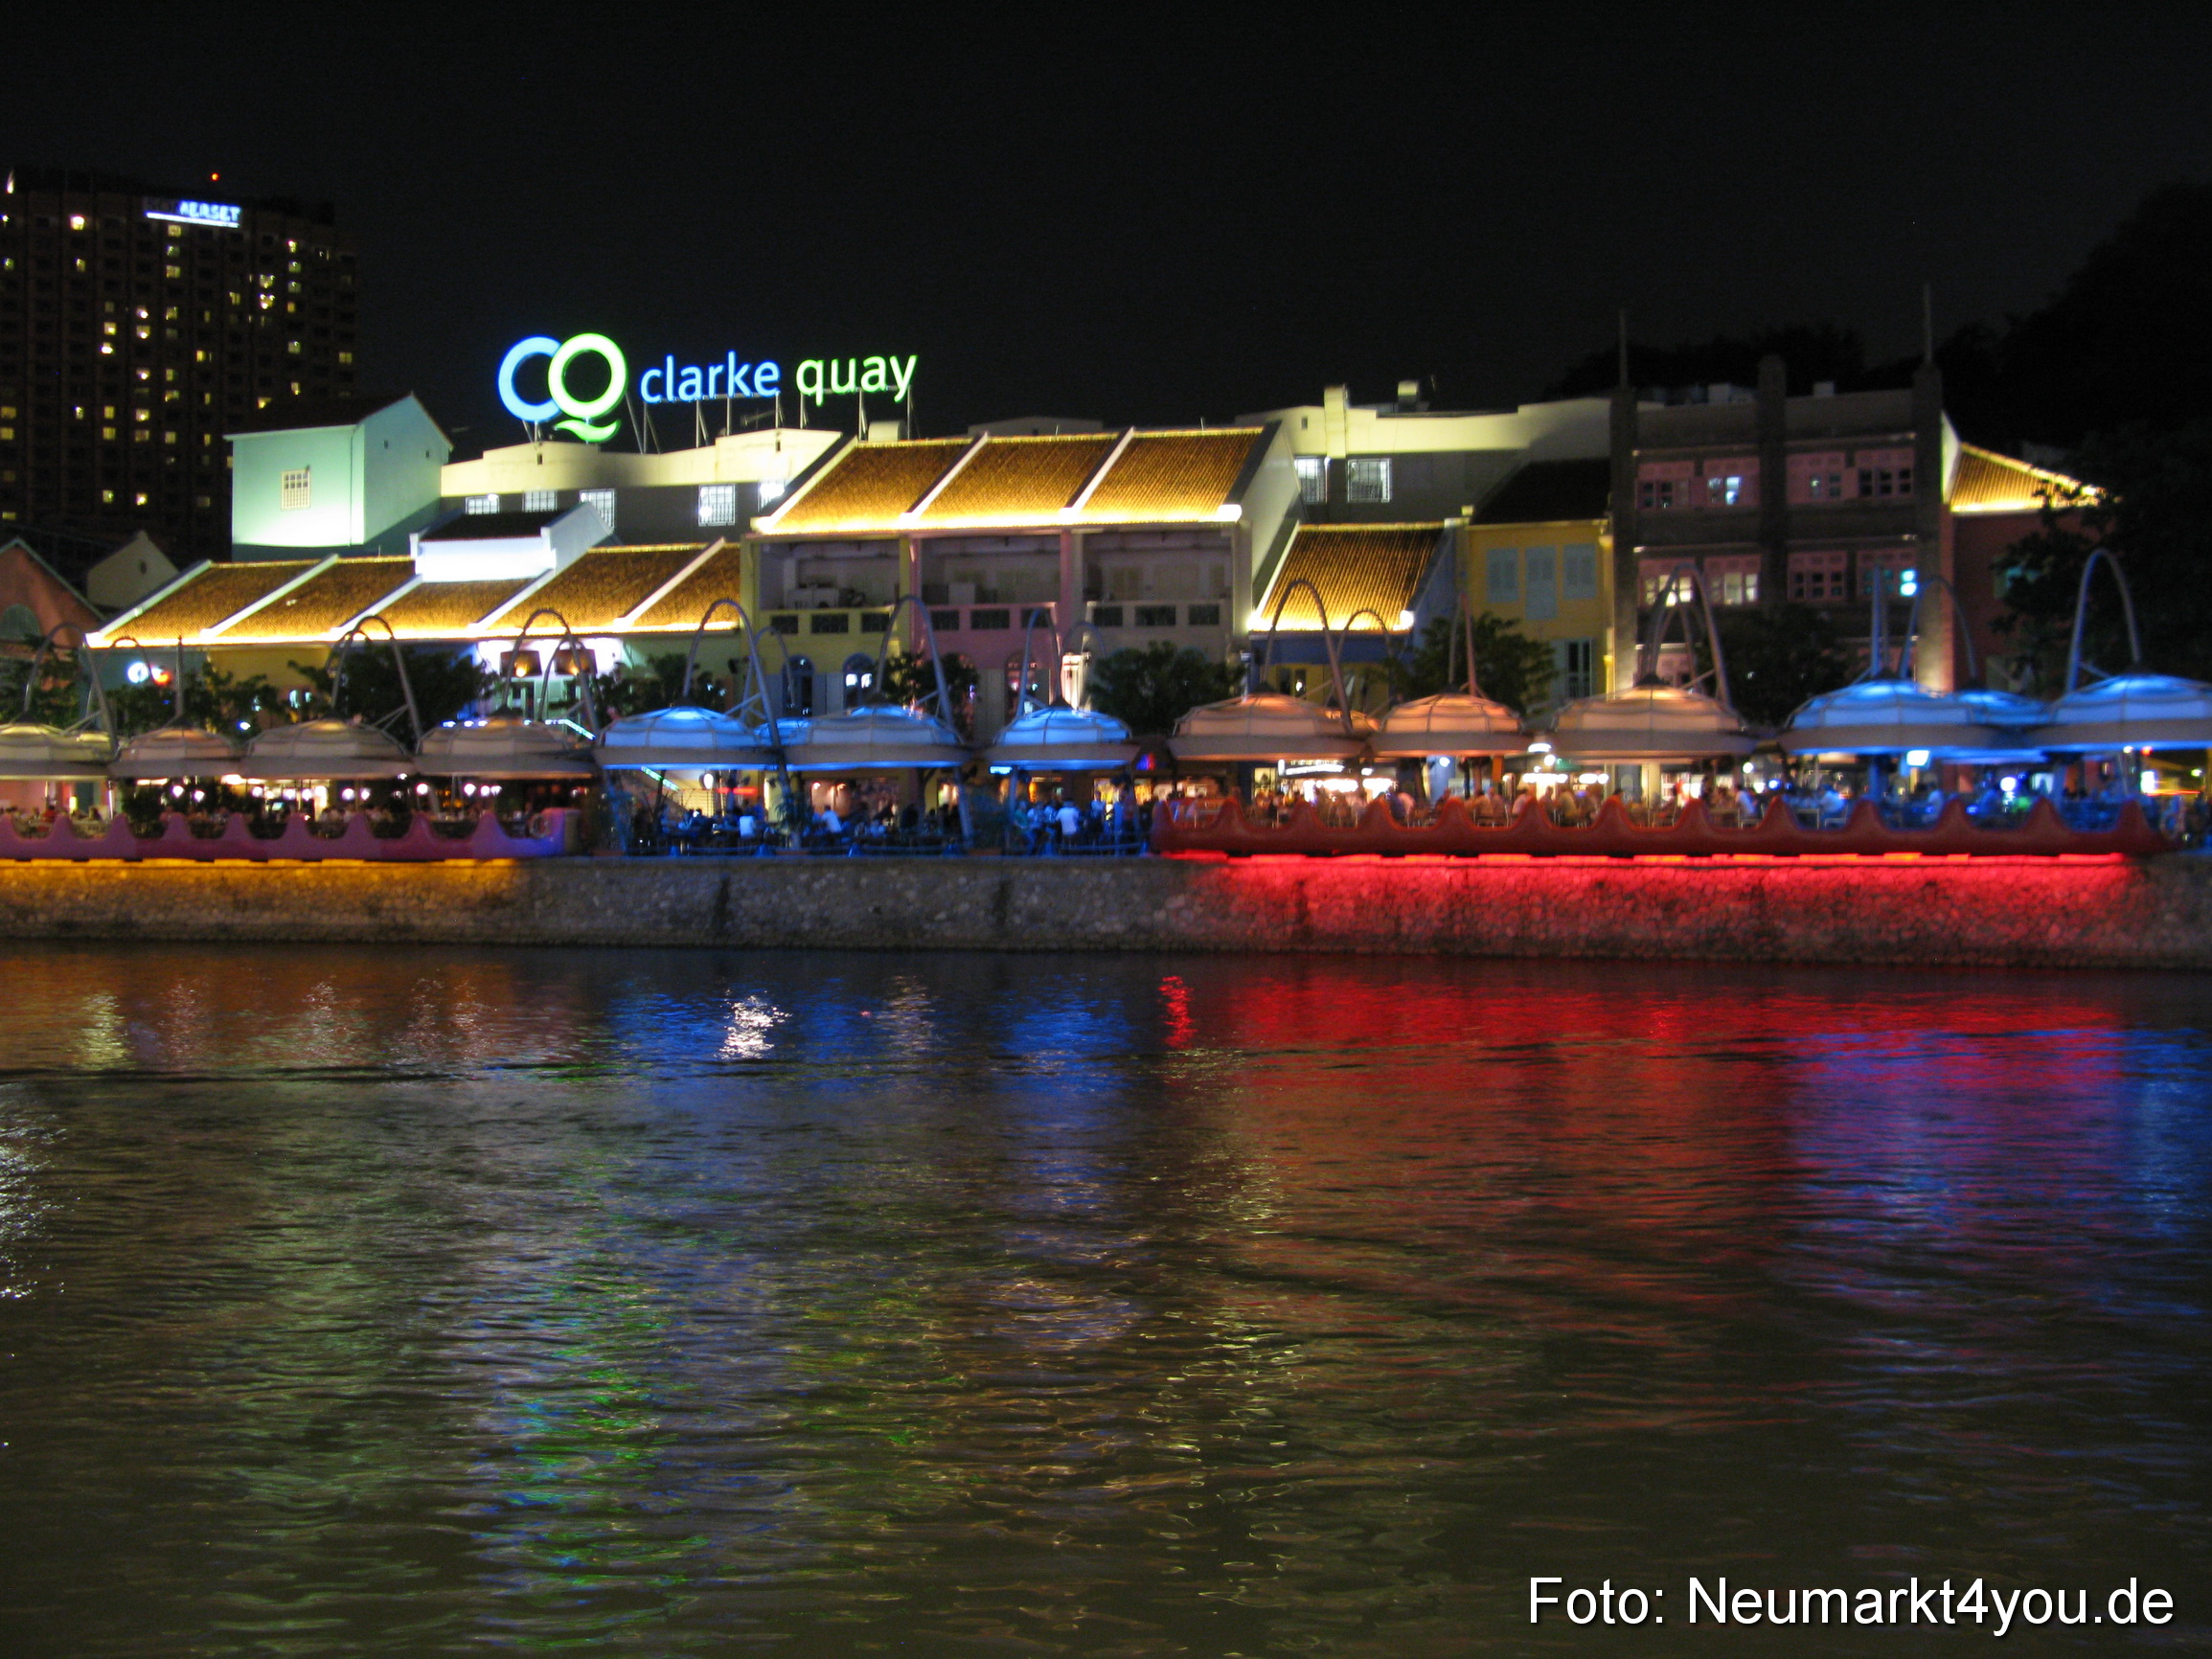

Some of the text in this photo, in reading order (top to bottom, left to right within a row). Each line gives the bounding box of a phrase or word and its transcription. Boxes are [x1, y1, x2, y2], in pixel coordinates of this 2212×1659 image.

[497, 333, 917, 442] CQ clarke quay
